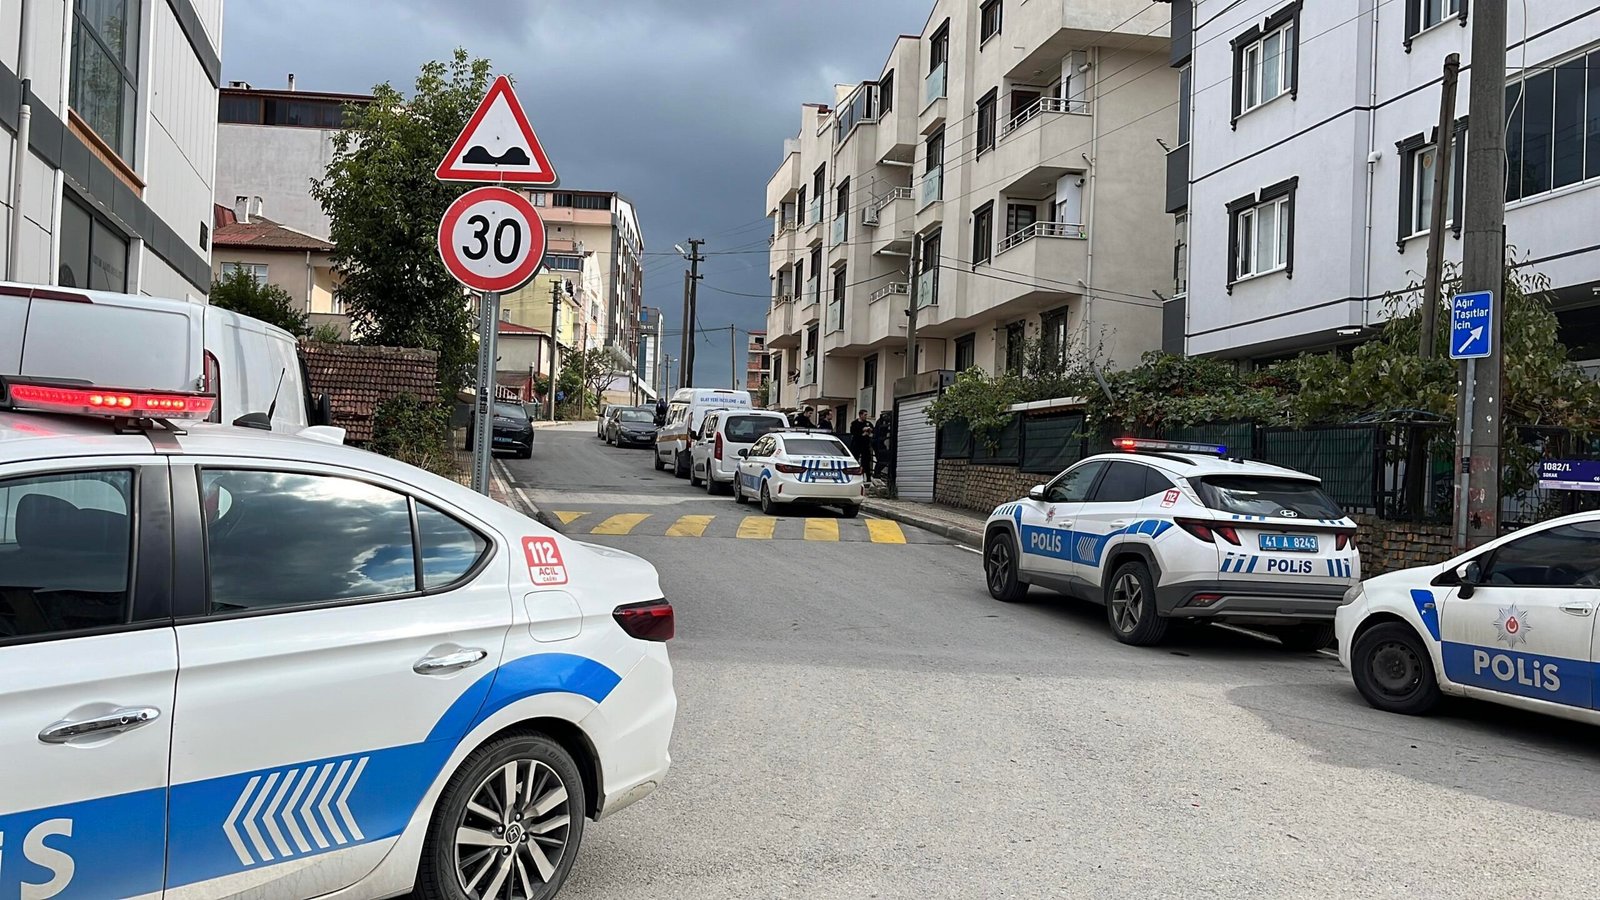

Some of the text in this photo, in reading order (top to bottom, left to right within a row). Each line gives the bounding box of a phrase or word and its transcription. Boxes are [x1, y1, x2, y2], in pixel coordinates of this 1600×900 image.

[462, 214, 522, 264] 30
[1455, 298, 1475, 310] Ağır
[1455, 308, 1489, 320] Taşıtlar
[1265, 536, 1316, 549] 41 A 8243
[527, 541, 559, 564] 112
